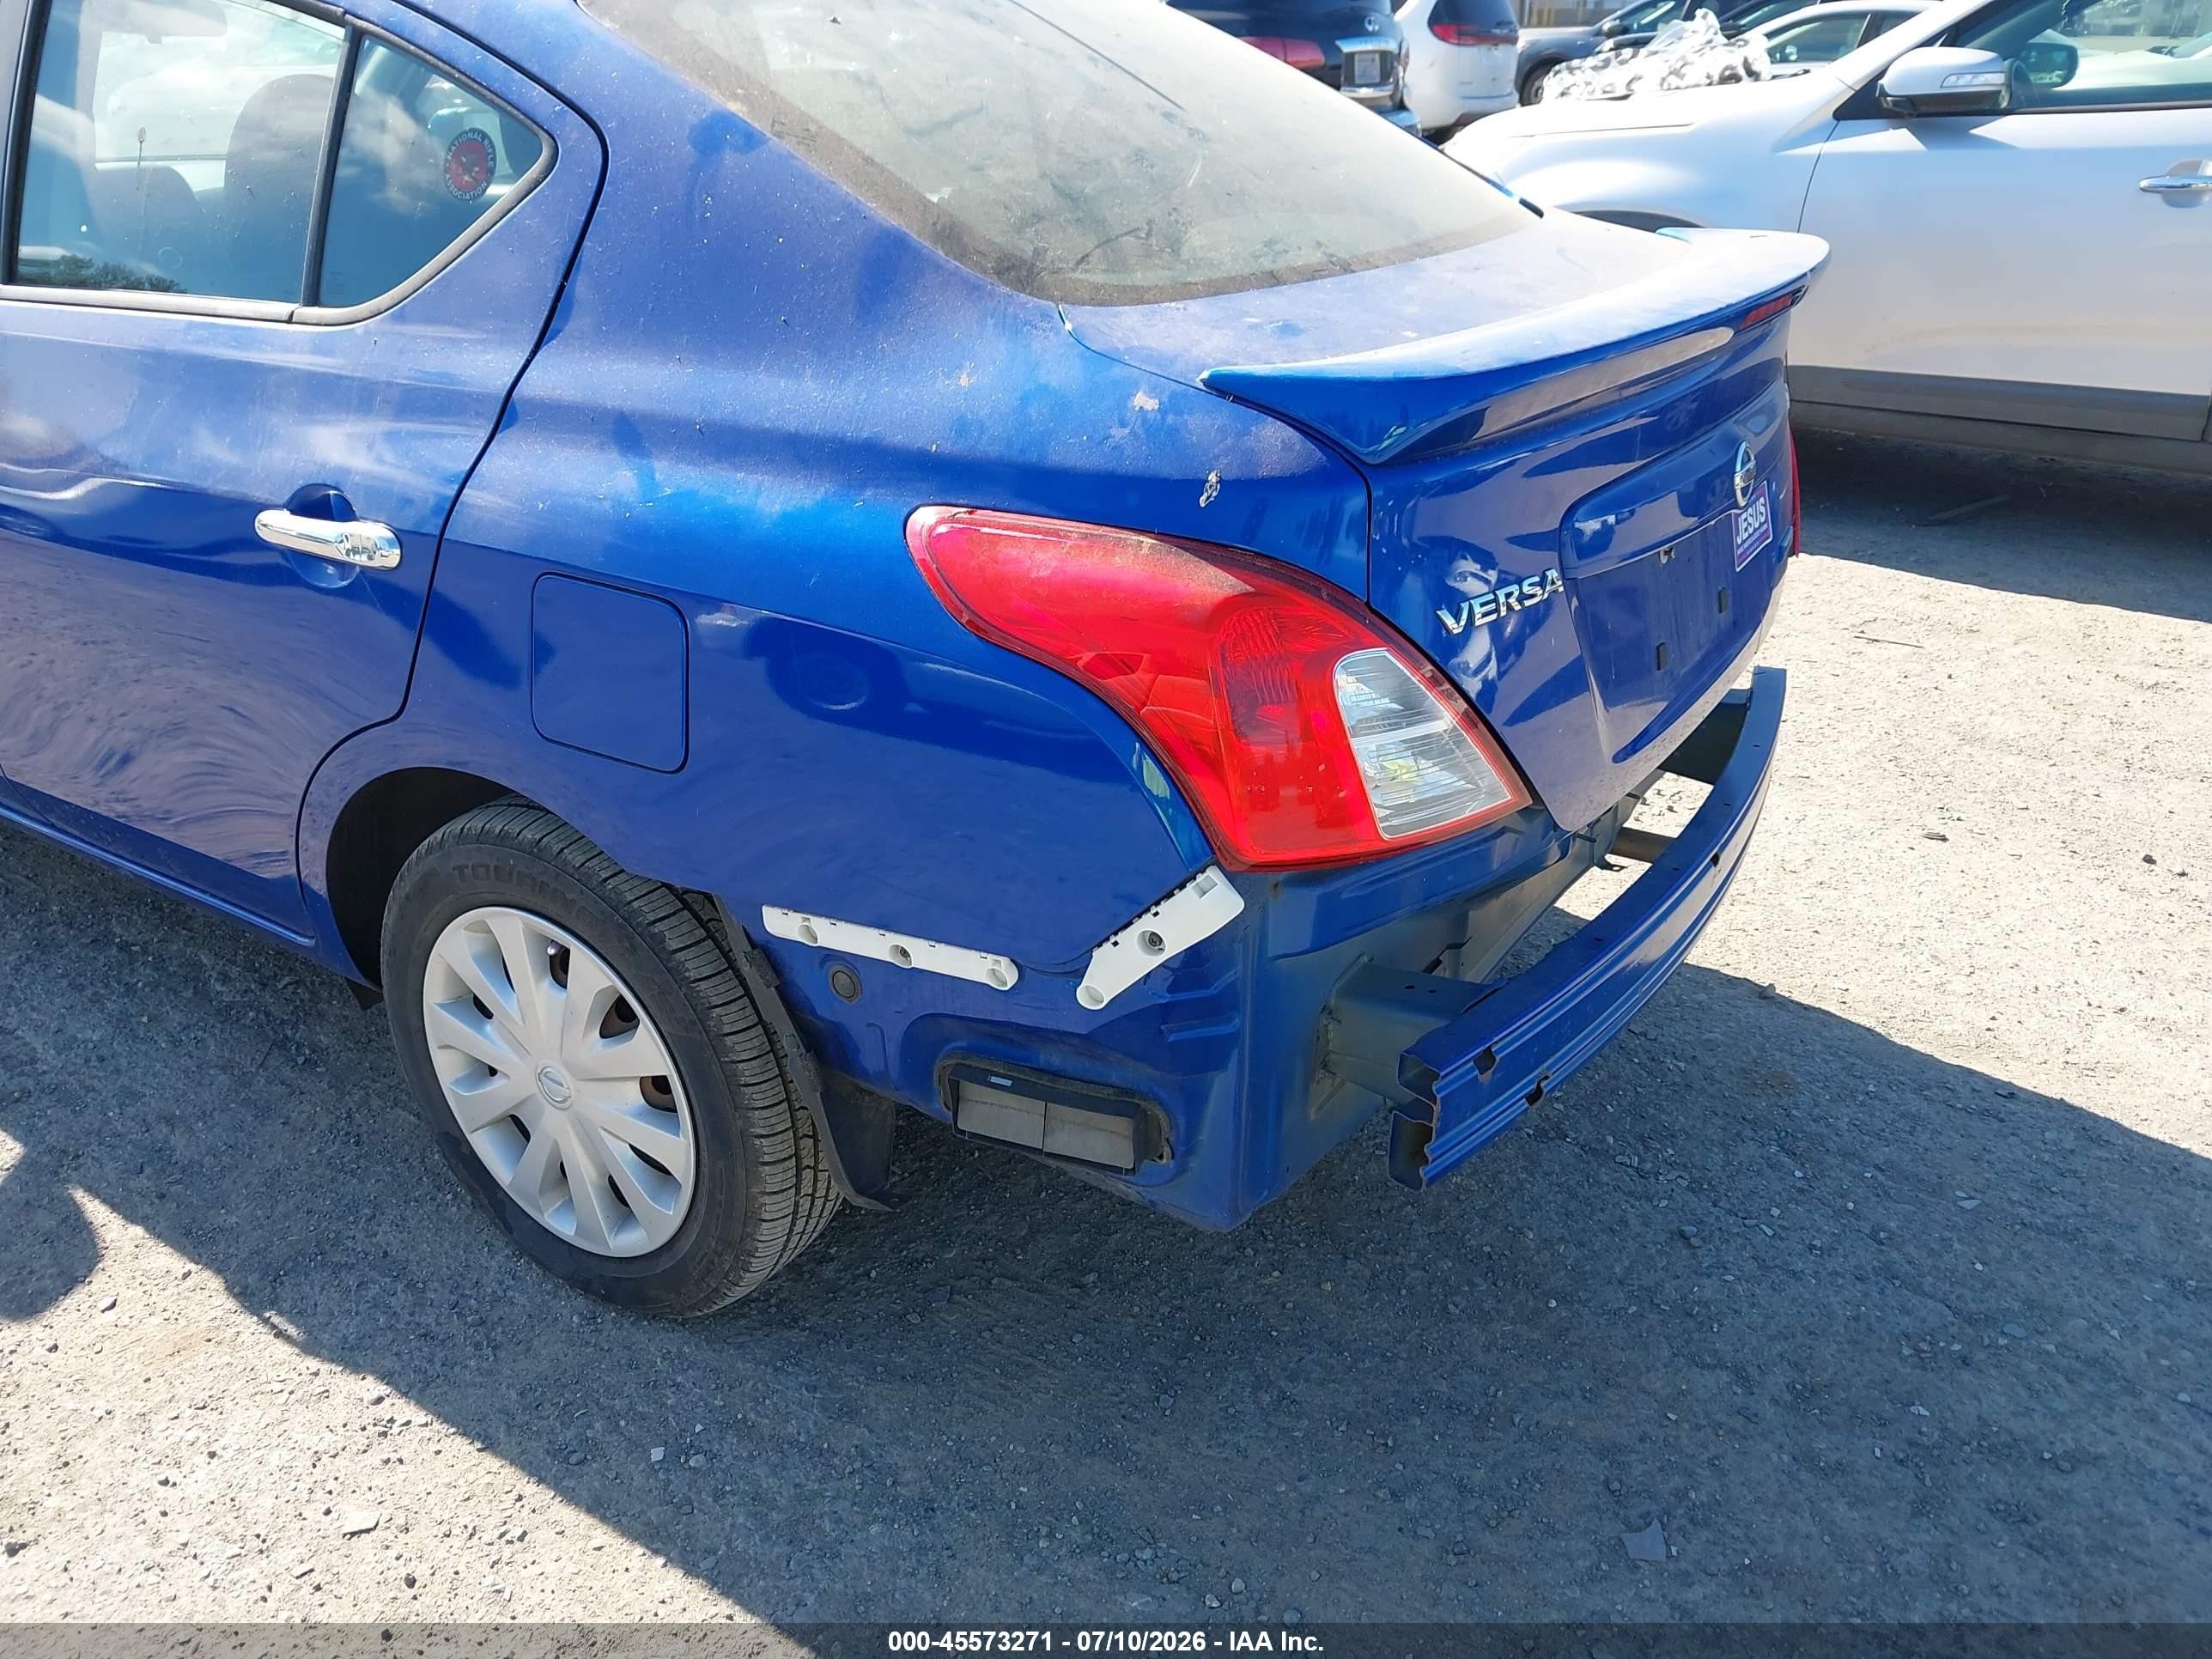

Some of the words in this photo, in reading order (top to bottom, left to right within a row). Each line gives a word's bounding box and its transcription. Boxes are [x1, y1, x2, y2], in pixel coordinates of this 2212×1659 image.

[447, 131, 483, 161] NATIONAL
[483, 138, 495, 167] RIFLE
[445, 173, 488, 199] ASSOCIATION
[1736, 496, 1766, 545] JESUS
[1436, 568, 1565, 635] VERSA
